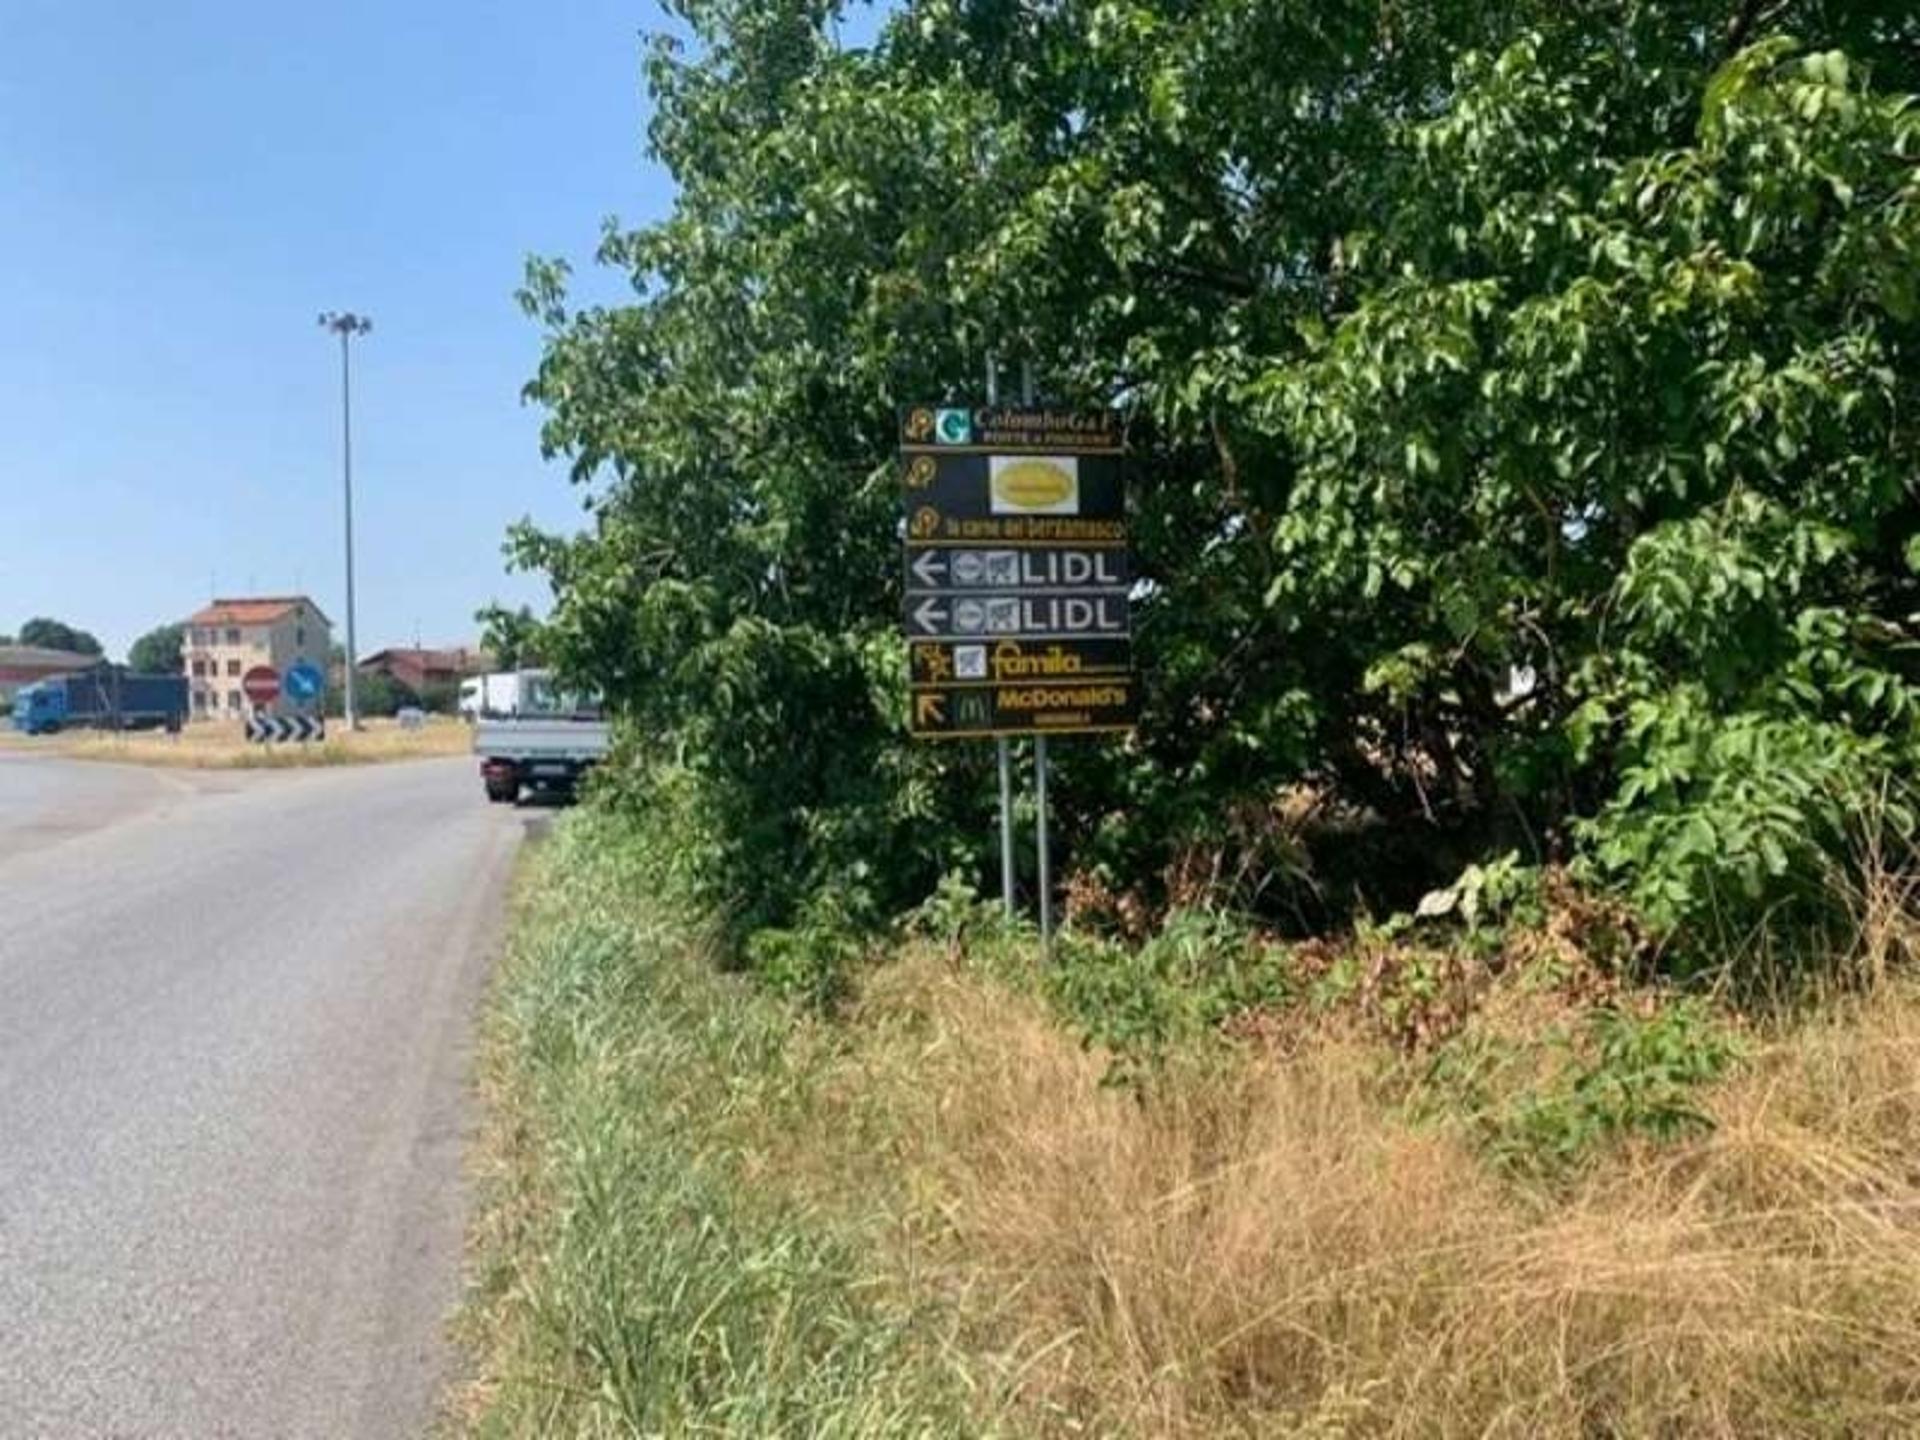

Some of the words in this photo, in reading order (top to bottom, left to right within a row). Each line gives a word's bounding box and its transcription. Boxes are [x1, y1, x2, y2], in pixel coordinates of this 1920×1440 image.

[1022, 552, 1117, 583] LIDL
[1024, 599, 1120, 629] LIDL
[991, 641, 1081, 681] famila
[997, 686, 1126, 709] McDonald's
